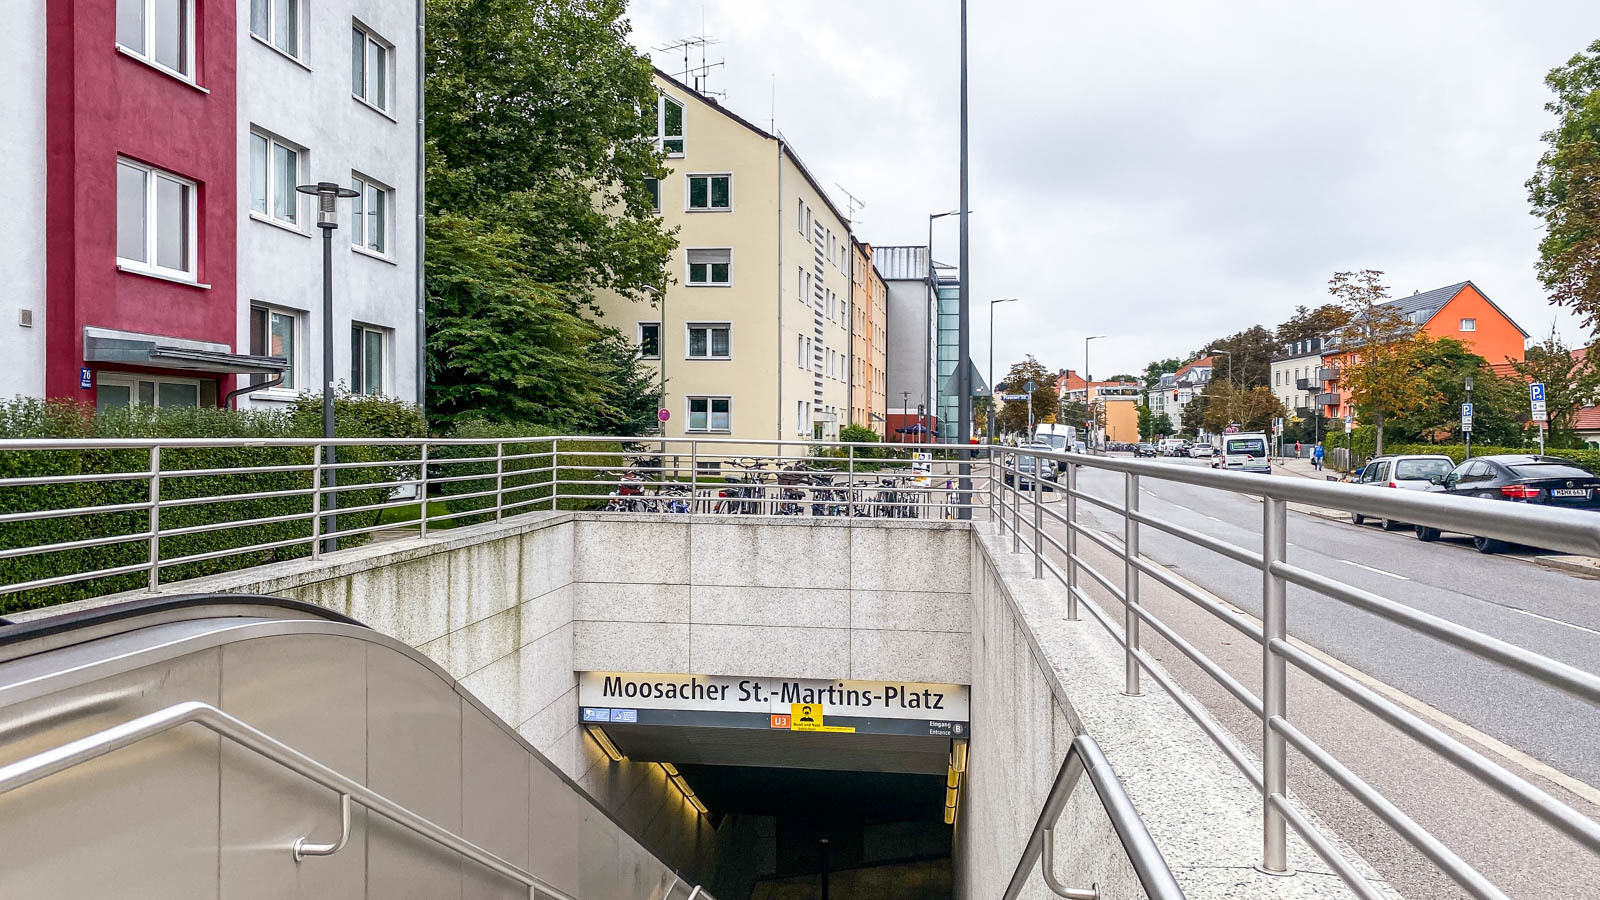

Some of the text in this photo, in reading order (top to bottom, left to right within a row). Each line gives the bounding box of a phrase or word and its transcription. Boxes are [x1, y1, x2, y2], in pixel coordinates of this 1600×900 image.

[82, 369, 91, 380] 76
[603, 676, 945, 710] Moosacher St.-Martins-Platz
[774, 717, 787, 726] U3
[930, 721, 951, 729] Eingang
[955, 725, 961, 733] B
